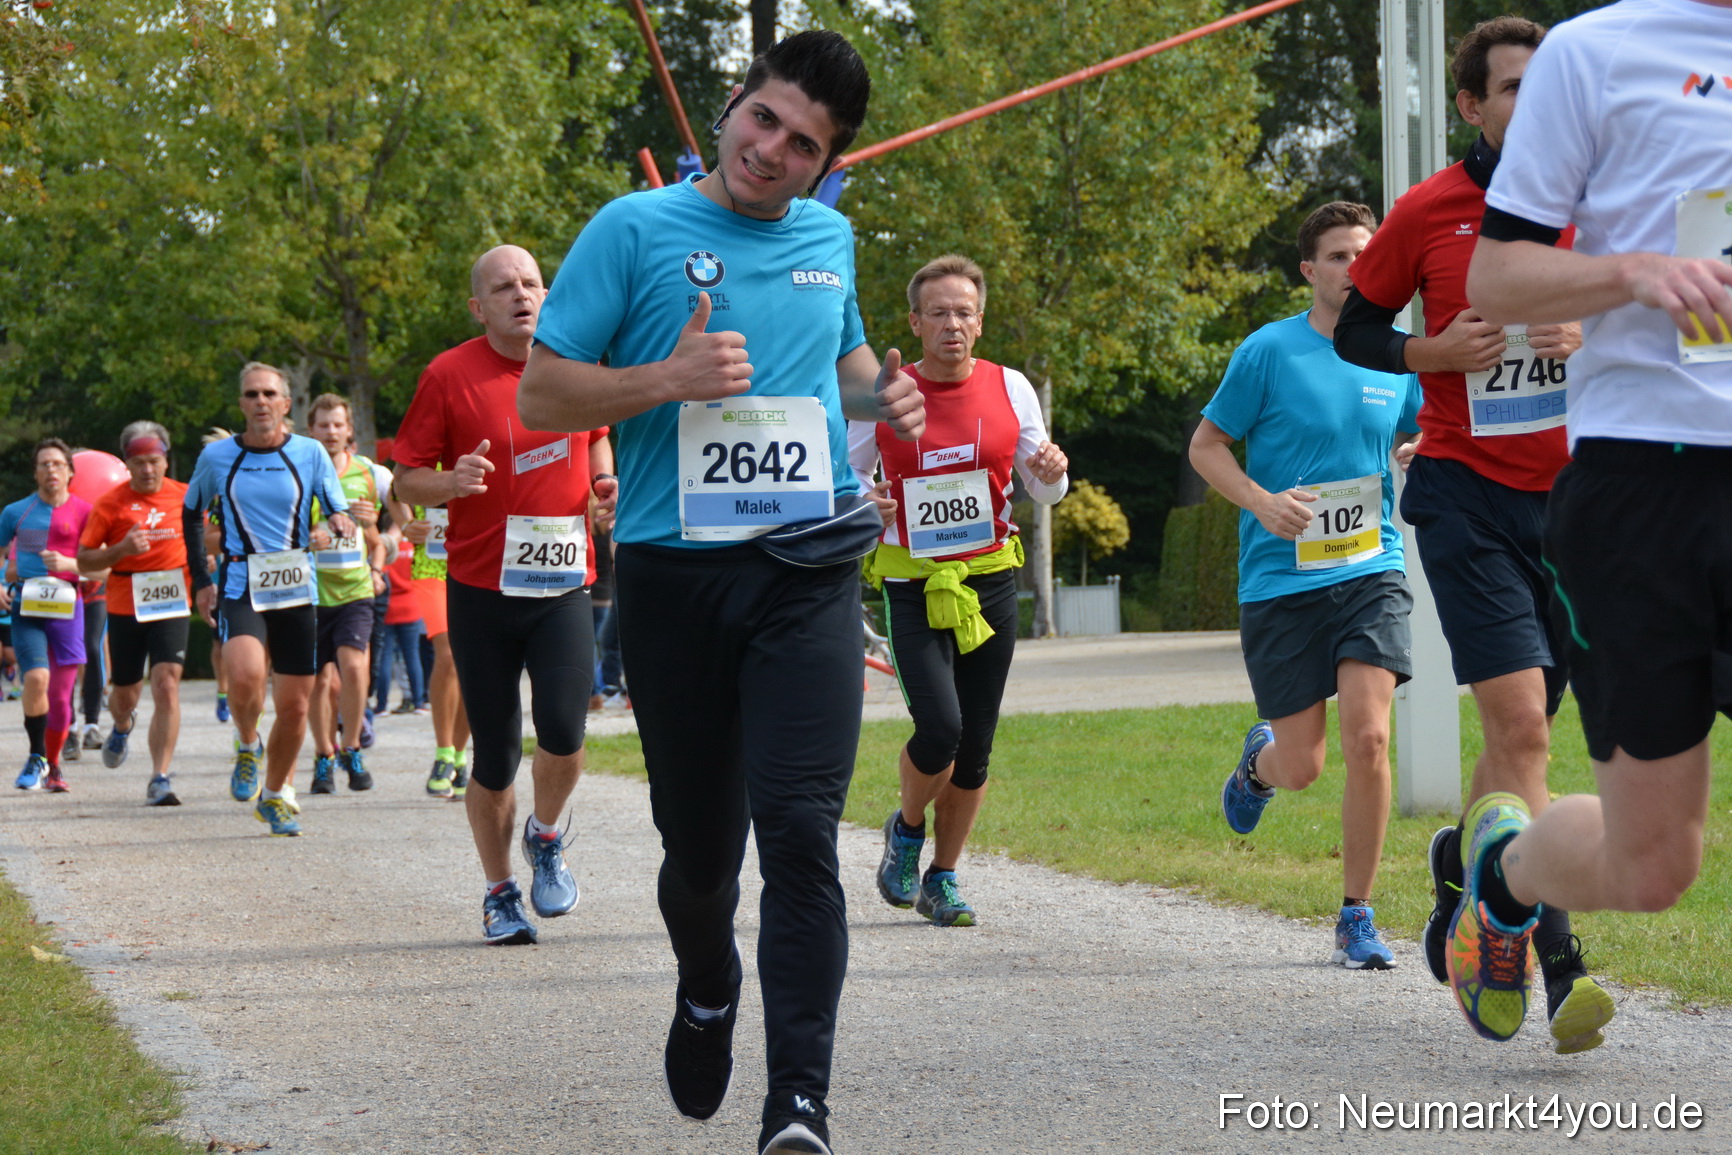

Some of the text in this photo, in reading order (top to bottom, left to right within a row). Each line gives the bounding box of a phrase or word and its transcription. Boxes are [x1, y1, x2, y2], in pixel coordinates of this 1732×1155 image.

[791, 269, 844, 290] BOCK
[1362, 396, 1387, 406] Dominik
[738, 410, 787, 422] BOCK
[1485, 396, 1564, 422] PHILIPP
[530, 448, 554, 464] DEHN
[702, 441, 810, 484] 2642
[936, 450, 961, 462] DEHN
[687, 479, 694, 487] D
[935, 480, 965, 491] BOCK
[1329, 486, 1361, 497] BOCK
[735, 499, 782, 515] Malek
[918, 496, 980, 526] 2088
[1318, 504, 1364, 535] 102
[936, 530, 968, 542] Markus
[517, 541, 577, 566] 2430
[1324, 539, 1360, 553] Dominik
[259, 567, 303, 588] 2700
[524, 574, 566, 584] Johannes
[40, 586, 58, 599] 37
[141, 584, 179, 602] 2490
